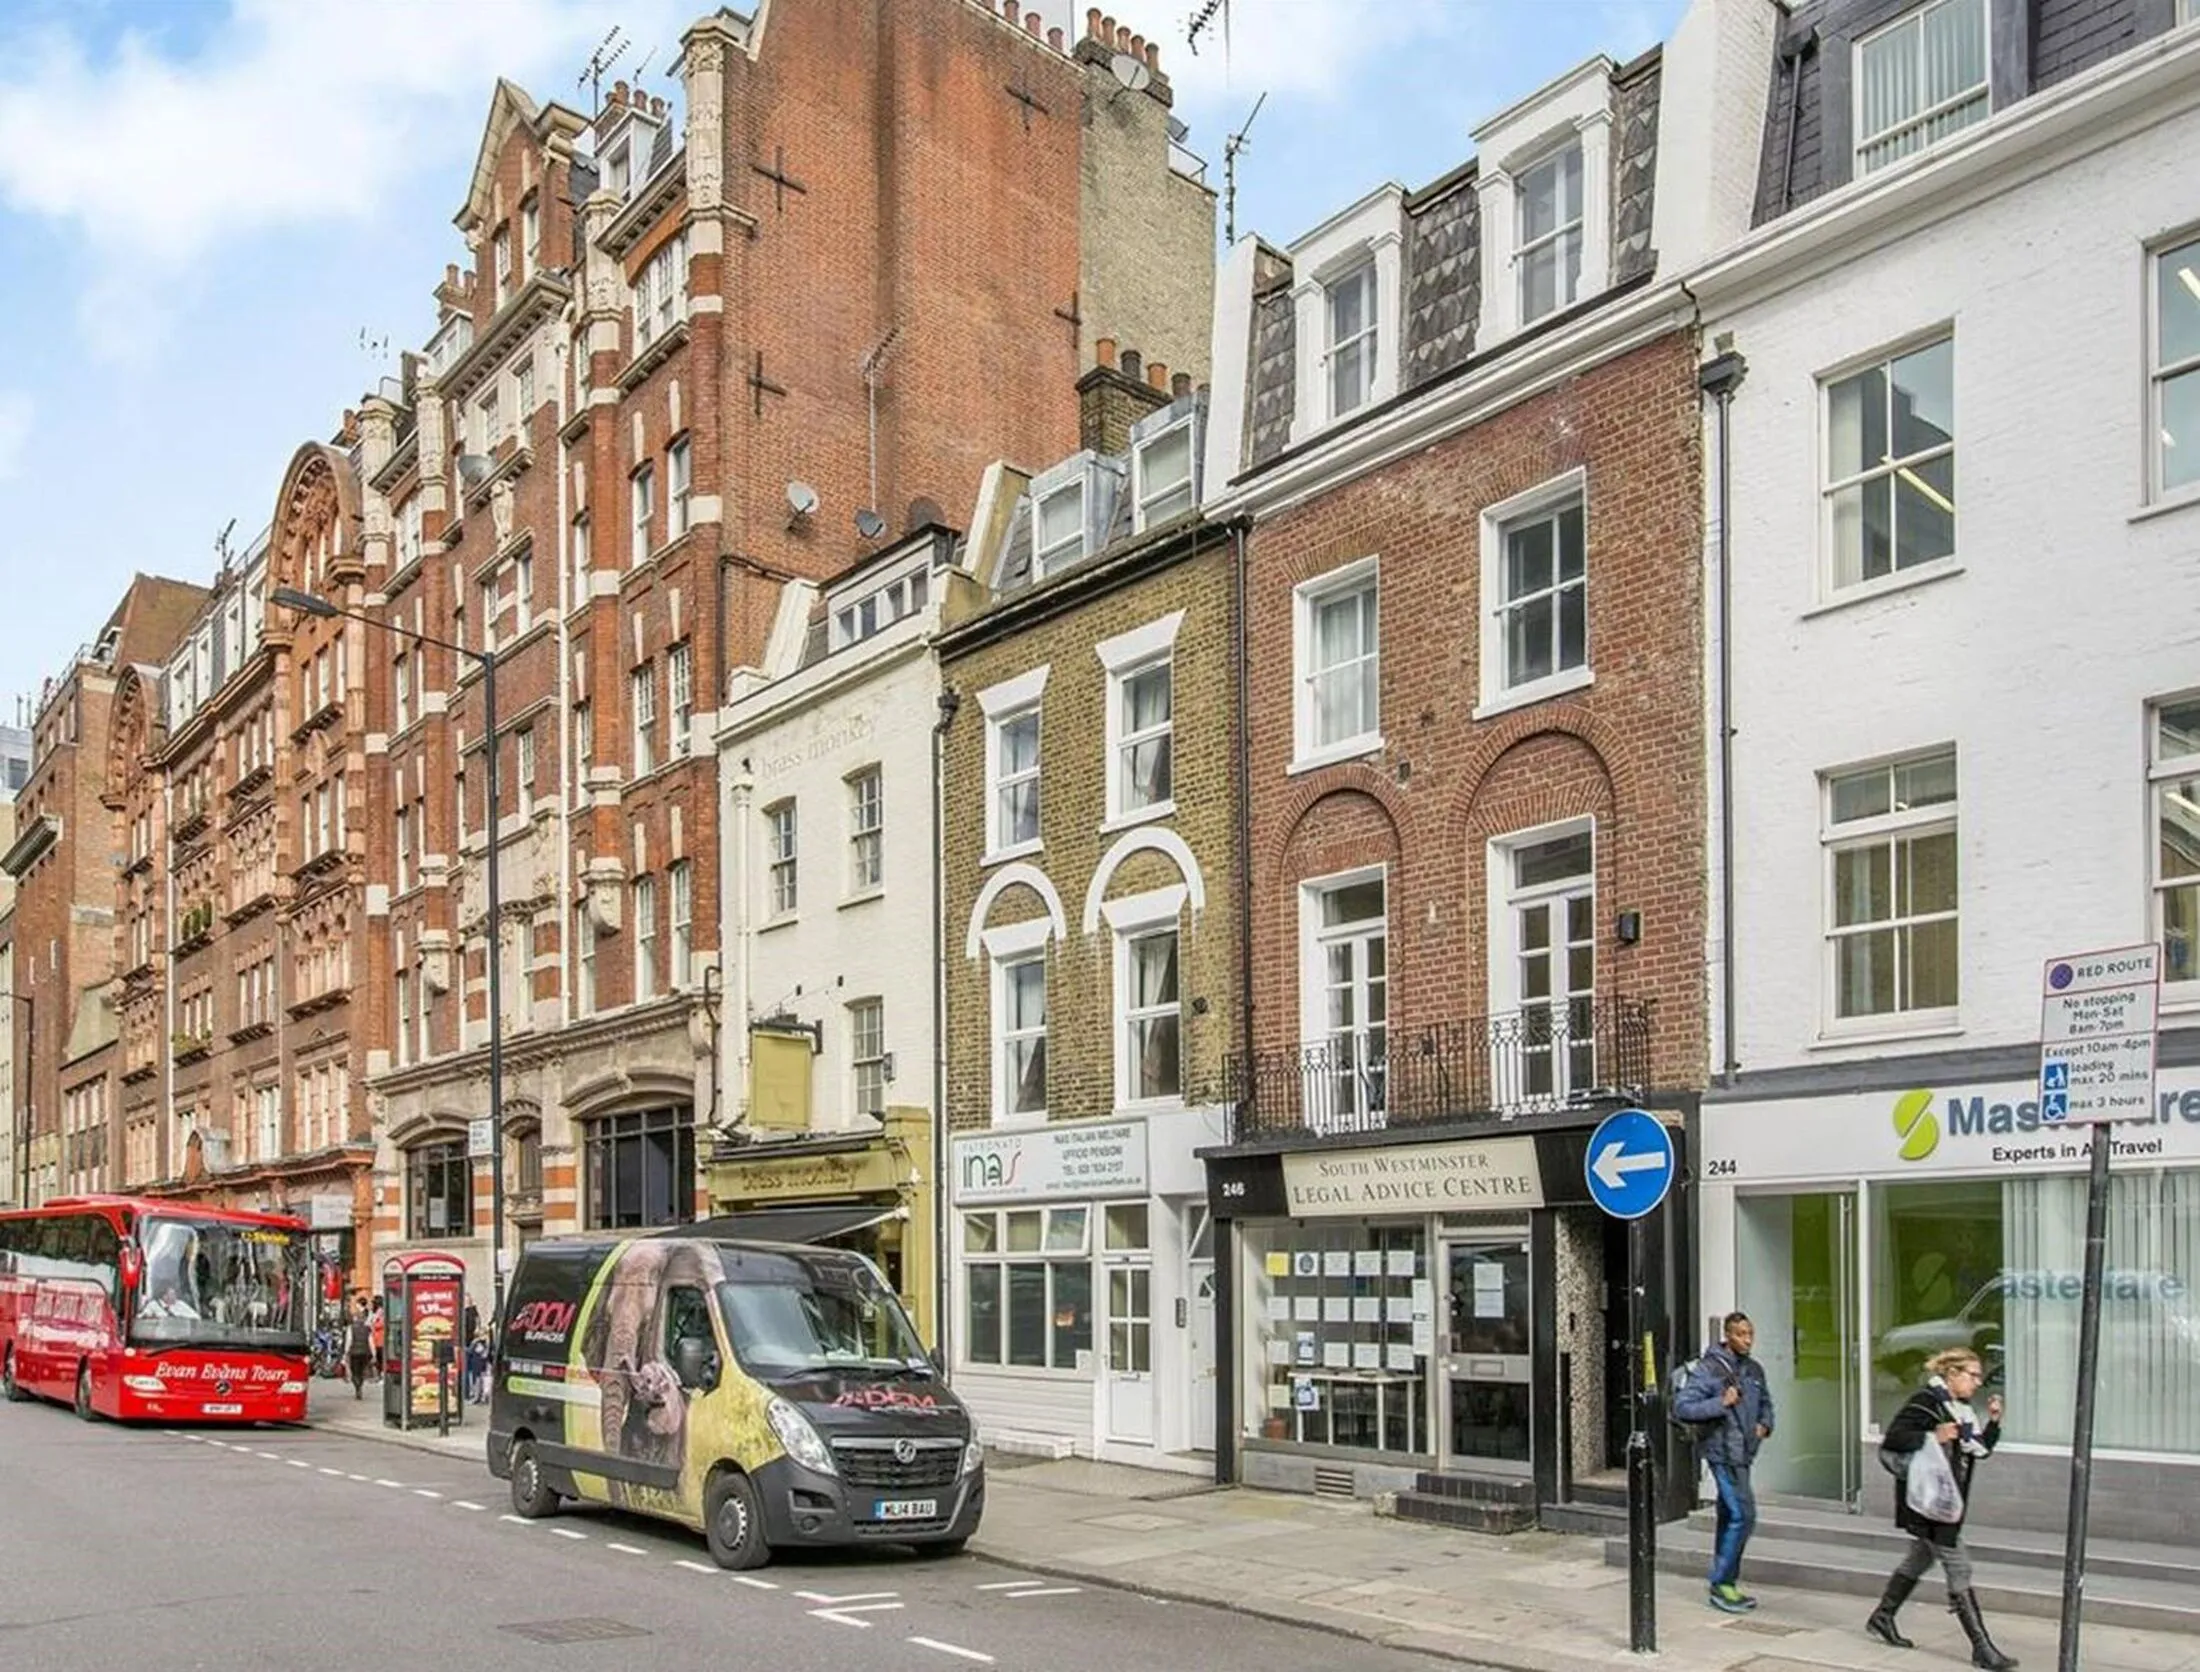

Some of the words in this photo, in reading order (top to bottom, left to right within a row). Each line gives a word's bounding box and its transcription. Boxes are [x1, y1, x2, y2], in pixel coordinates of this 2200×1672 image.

[2077, 965, 2102, 978] RED
[2107, 957, 2153, 974] ROUTE
[2063, 998, 2079, 1009] No
[2083, 990, 2136, 1009] stopping
[2045, 1043, 2085, 1058] Except
[2070, 1076, 2095, 1085] max
[2099, 1072, 2115, 1083] 20
[2118, 1068, 2149, 1081] mins
[2071, 1061, 2115, 1073] loading
[2069, 1101, 2093, 1109] max
[2109, 1095, 2146, 1106] hours
[1992, 1145, 2057, 1163] Experts
[2061, 1145, 2077, 1158] in
[2111, 1138, 2162, 1154] Travel
[1374, 1153, 1489, 1173] WESTMINSTER
[1708, 1160, 1737, 1175] 244
[1293, 1185, 1352, 1205] LEGAL
[1361, 1180, 1436, 1201] ADVICE
[1444, 1174, 1533, 1197] CENTRE
[155, 1361, 197, 1379] Evan
[201, 1363, 248, 1381] Evans
[251, 1364, 291, 1382] Tours
